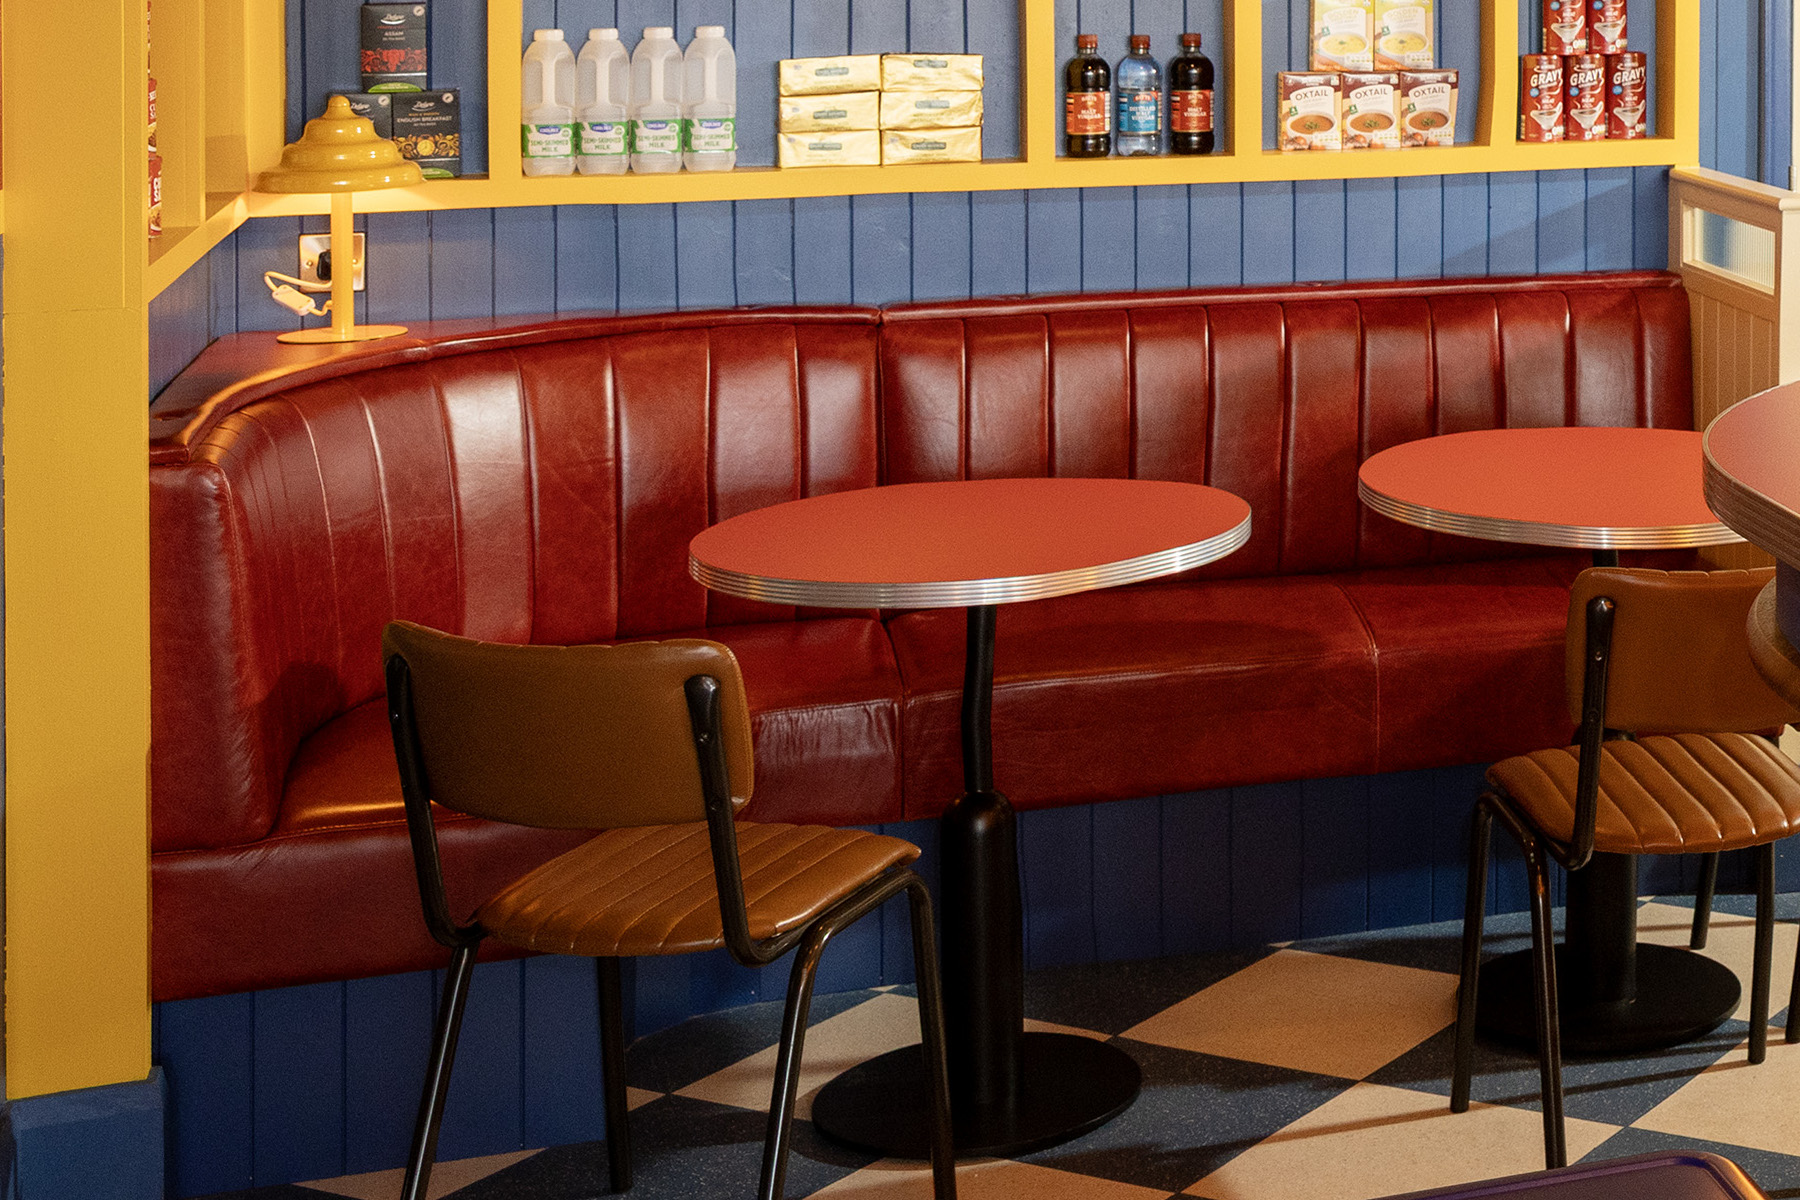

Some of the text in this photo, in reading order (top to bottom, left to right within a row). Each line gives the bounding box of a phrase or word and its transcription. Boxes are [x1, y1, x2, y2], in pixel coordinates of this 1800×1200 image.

[1530, 68, 1562, 87] GRAVY
[1570, 68, 1604, 86] GRAVY
[1612, 66, 1646, 84] GRAVY
[1295, 90, 1329, 101] OXTAIL
[1354, 88, 1388, 100] OXTAIL
[1413, 87, 1446, 98] OXTAIL
